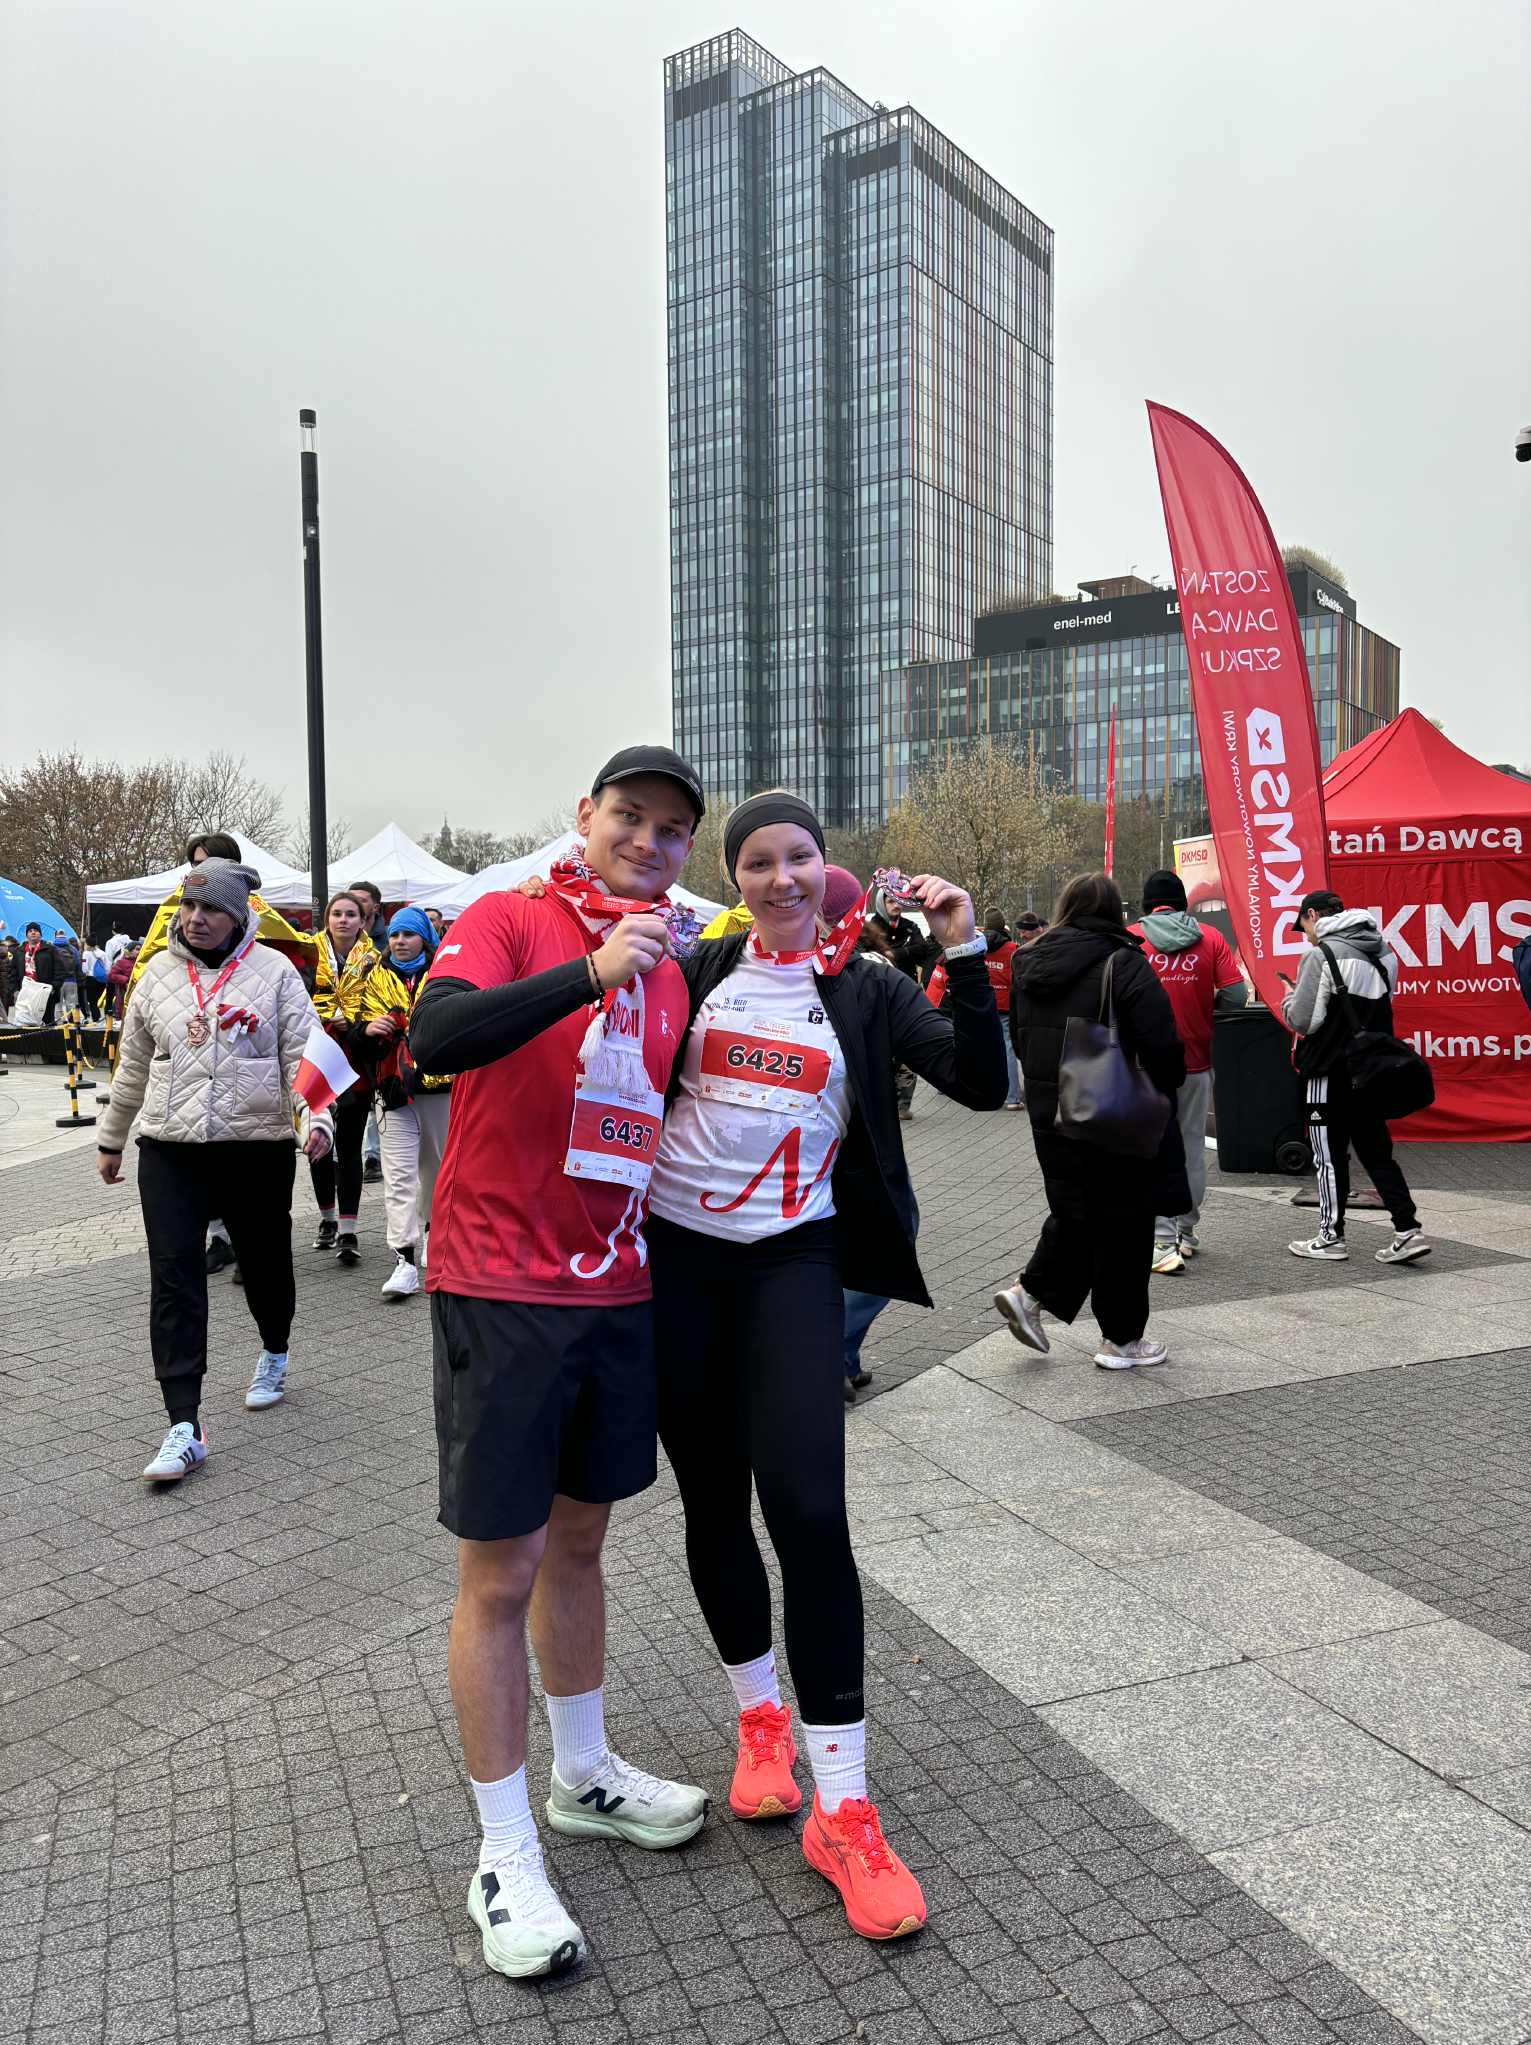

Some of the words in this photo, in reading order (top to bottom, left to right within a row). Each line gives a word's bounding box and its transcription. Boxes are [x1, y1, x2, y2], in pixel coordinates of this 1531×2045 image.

[1053, 610, 1112, 630] enel-med
[1399, 825, 1523, 855] Dawcą
[1181, 850, 1202, 864] DKMS
[726, 1044, 804, 1078] 6425
[599, 1116, 654, 1152] 6437
